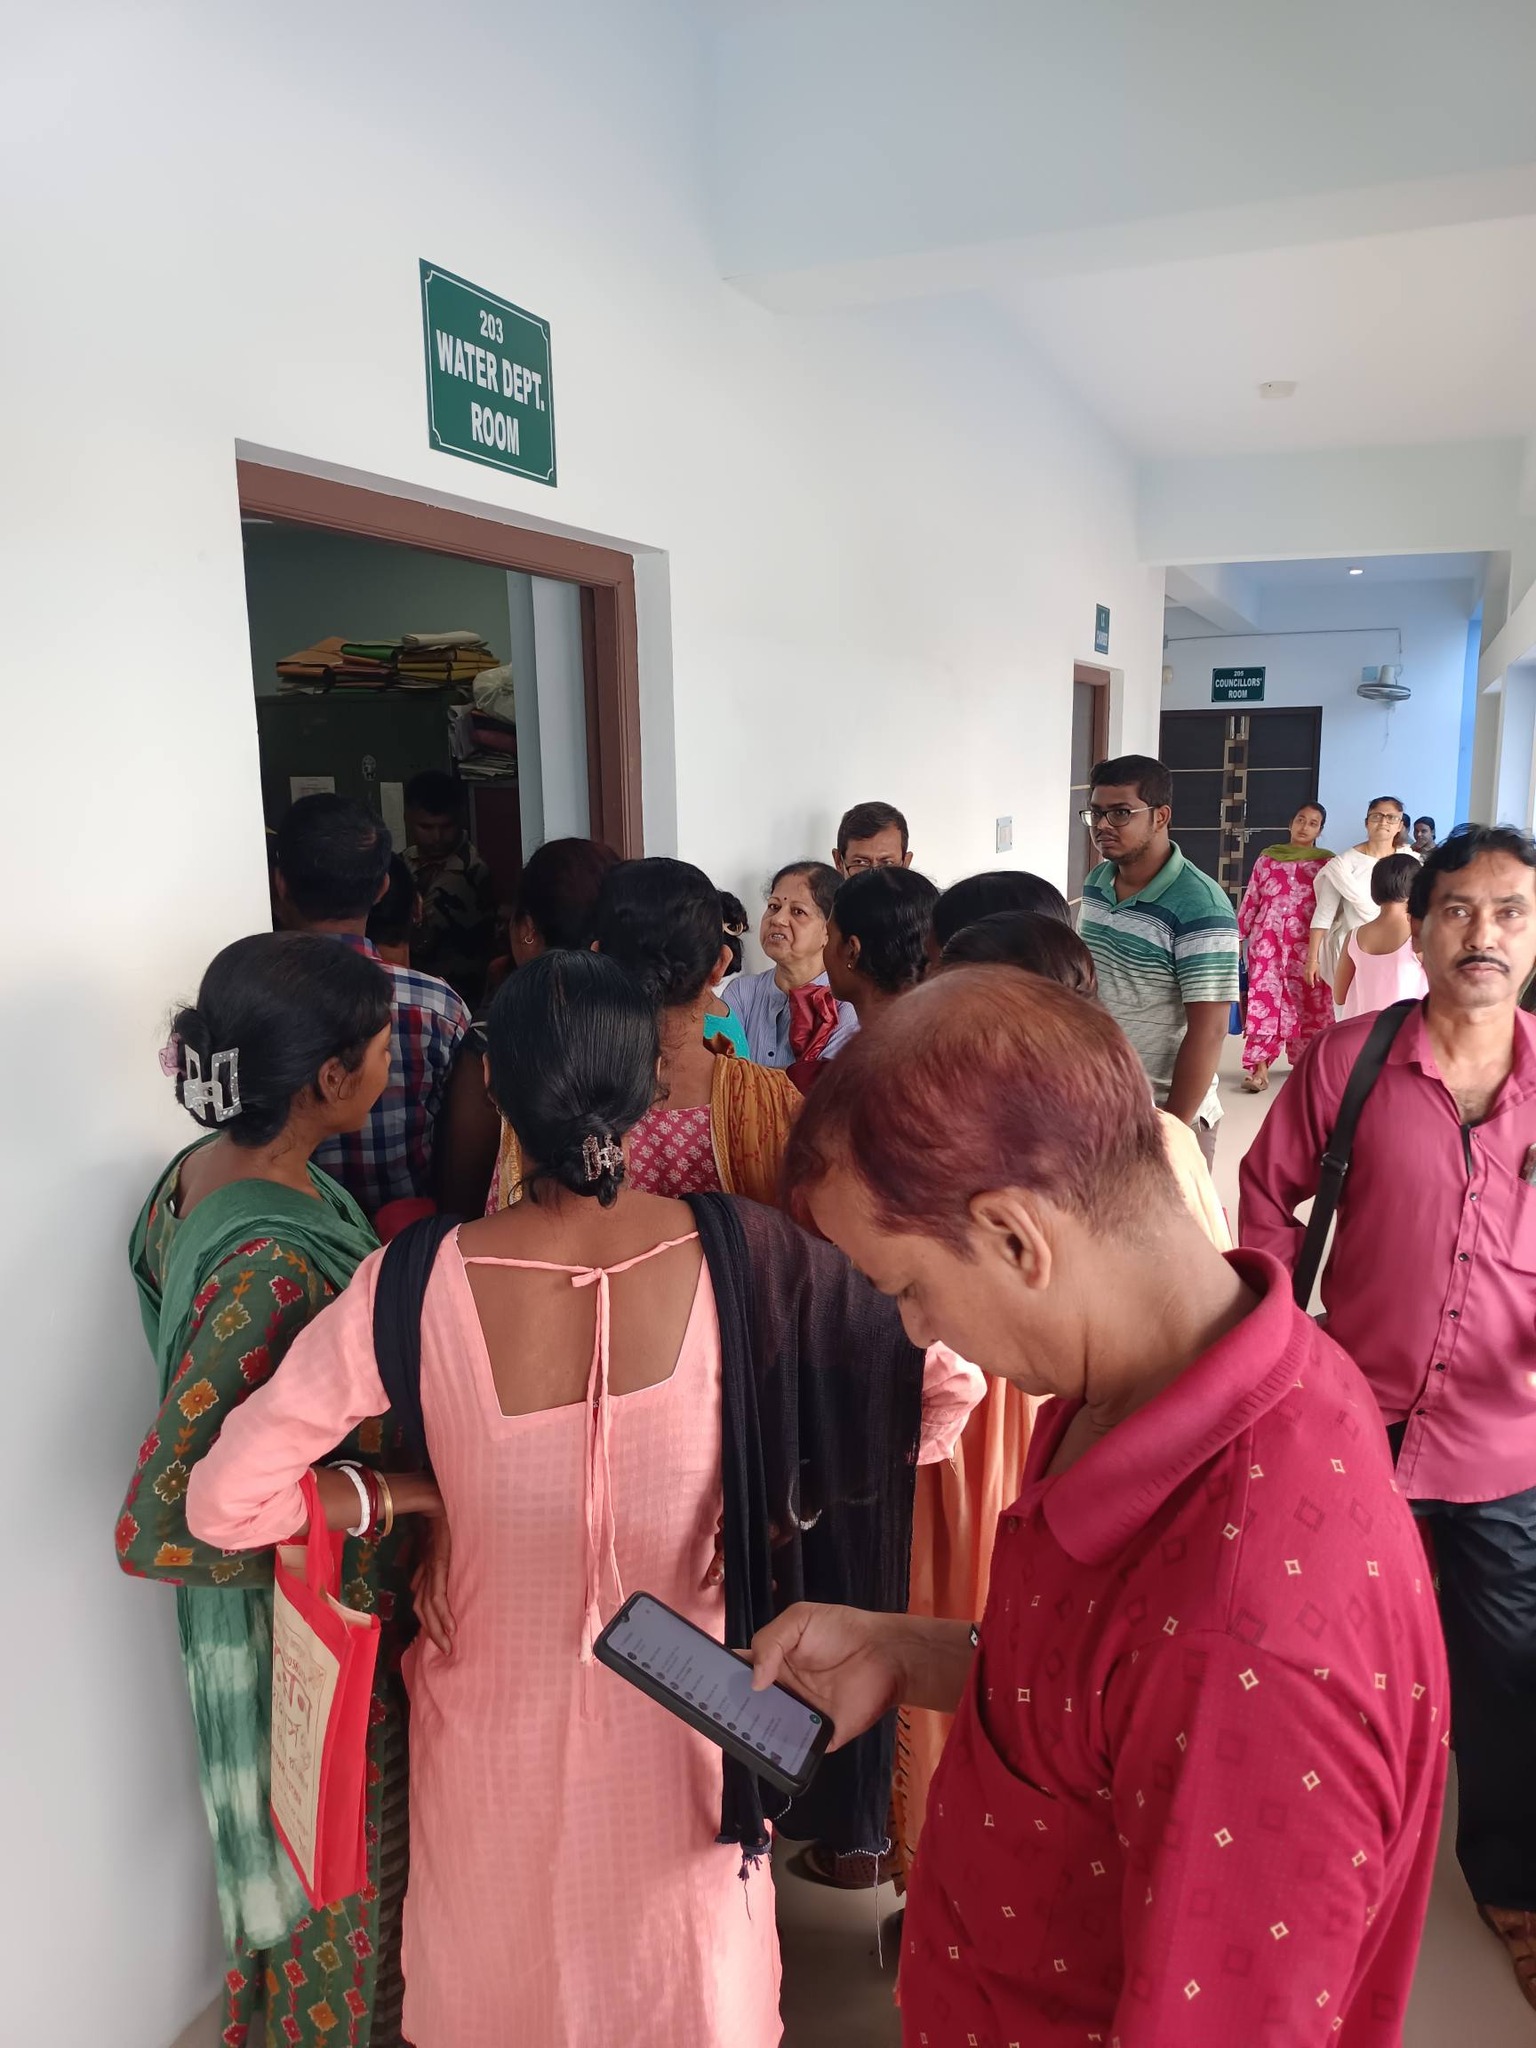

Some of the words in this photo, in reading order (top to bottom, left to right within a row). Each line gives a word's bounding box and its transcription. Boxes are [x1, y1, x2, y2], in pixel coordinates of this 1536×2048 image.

[479, 310, 504, 344] 203
[436, 329, 499, 393] WATER
[502, 358, 545, 411] DEPT.
[471, 402, 520, 456] ROOM
[1228, 689, 1248, 699] ROOM
